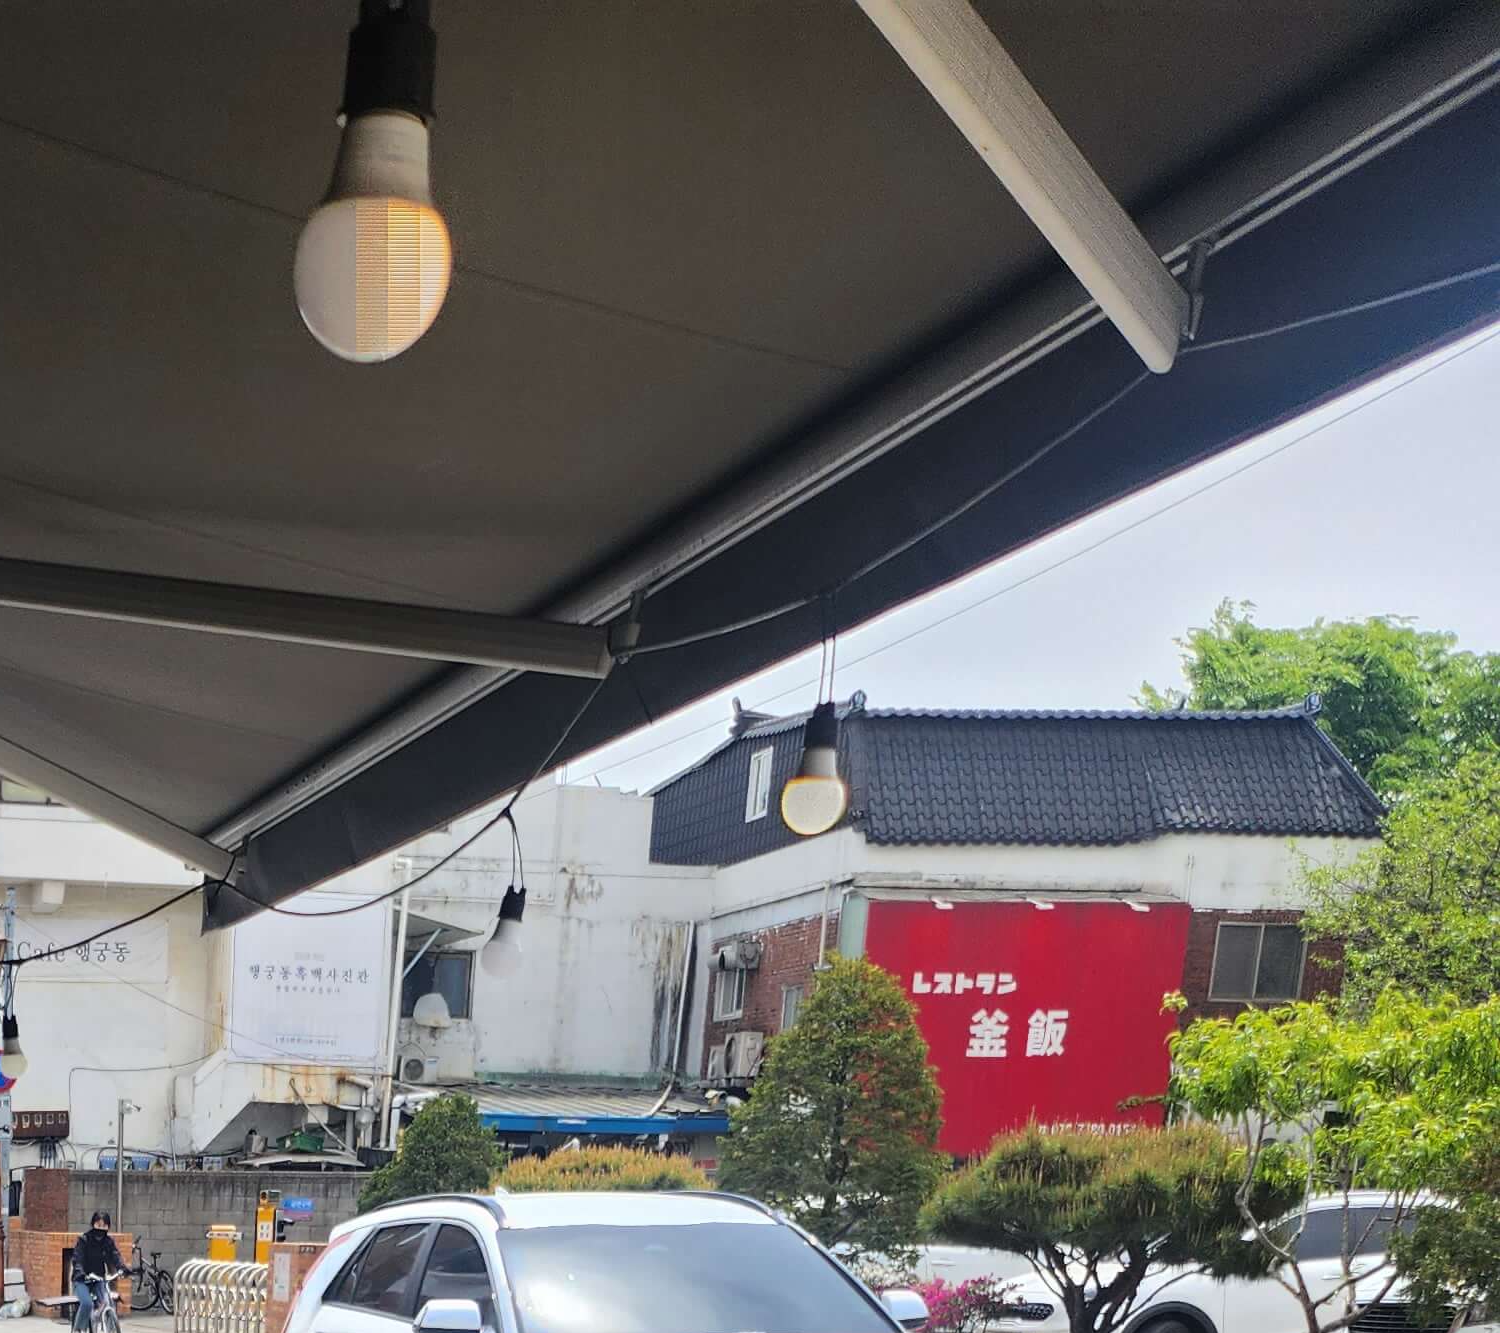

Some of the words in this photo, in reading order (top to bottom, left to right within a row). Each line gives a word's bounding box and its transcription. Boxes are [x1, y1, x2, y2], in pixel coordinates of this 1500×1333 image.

[17, 941, 66, 962] Cafe
[76, 942, 131, 962] 행궁동
[912, 972, 1017, 995] レストラン
